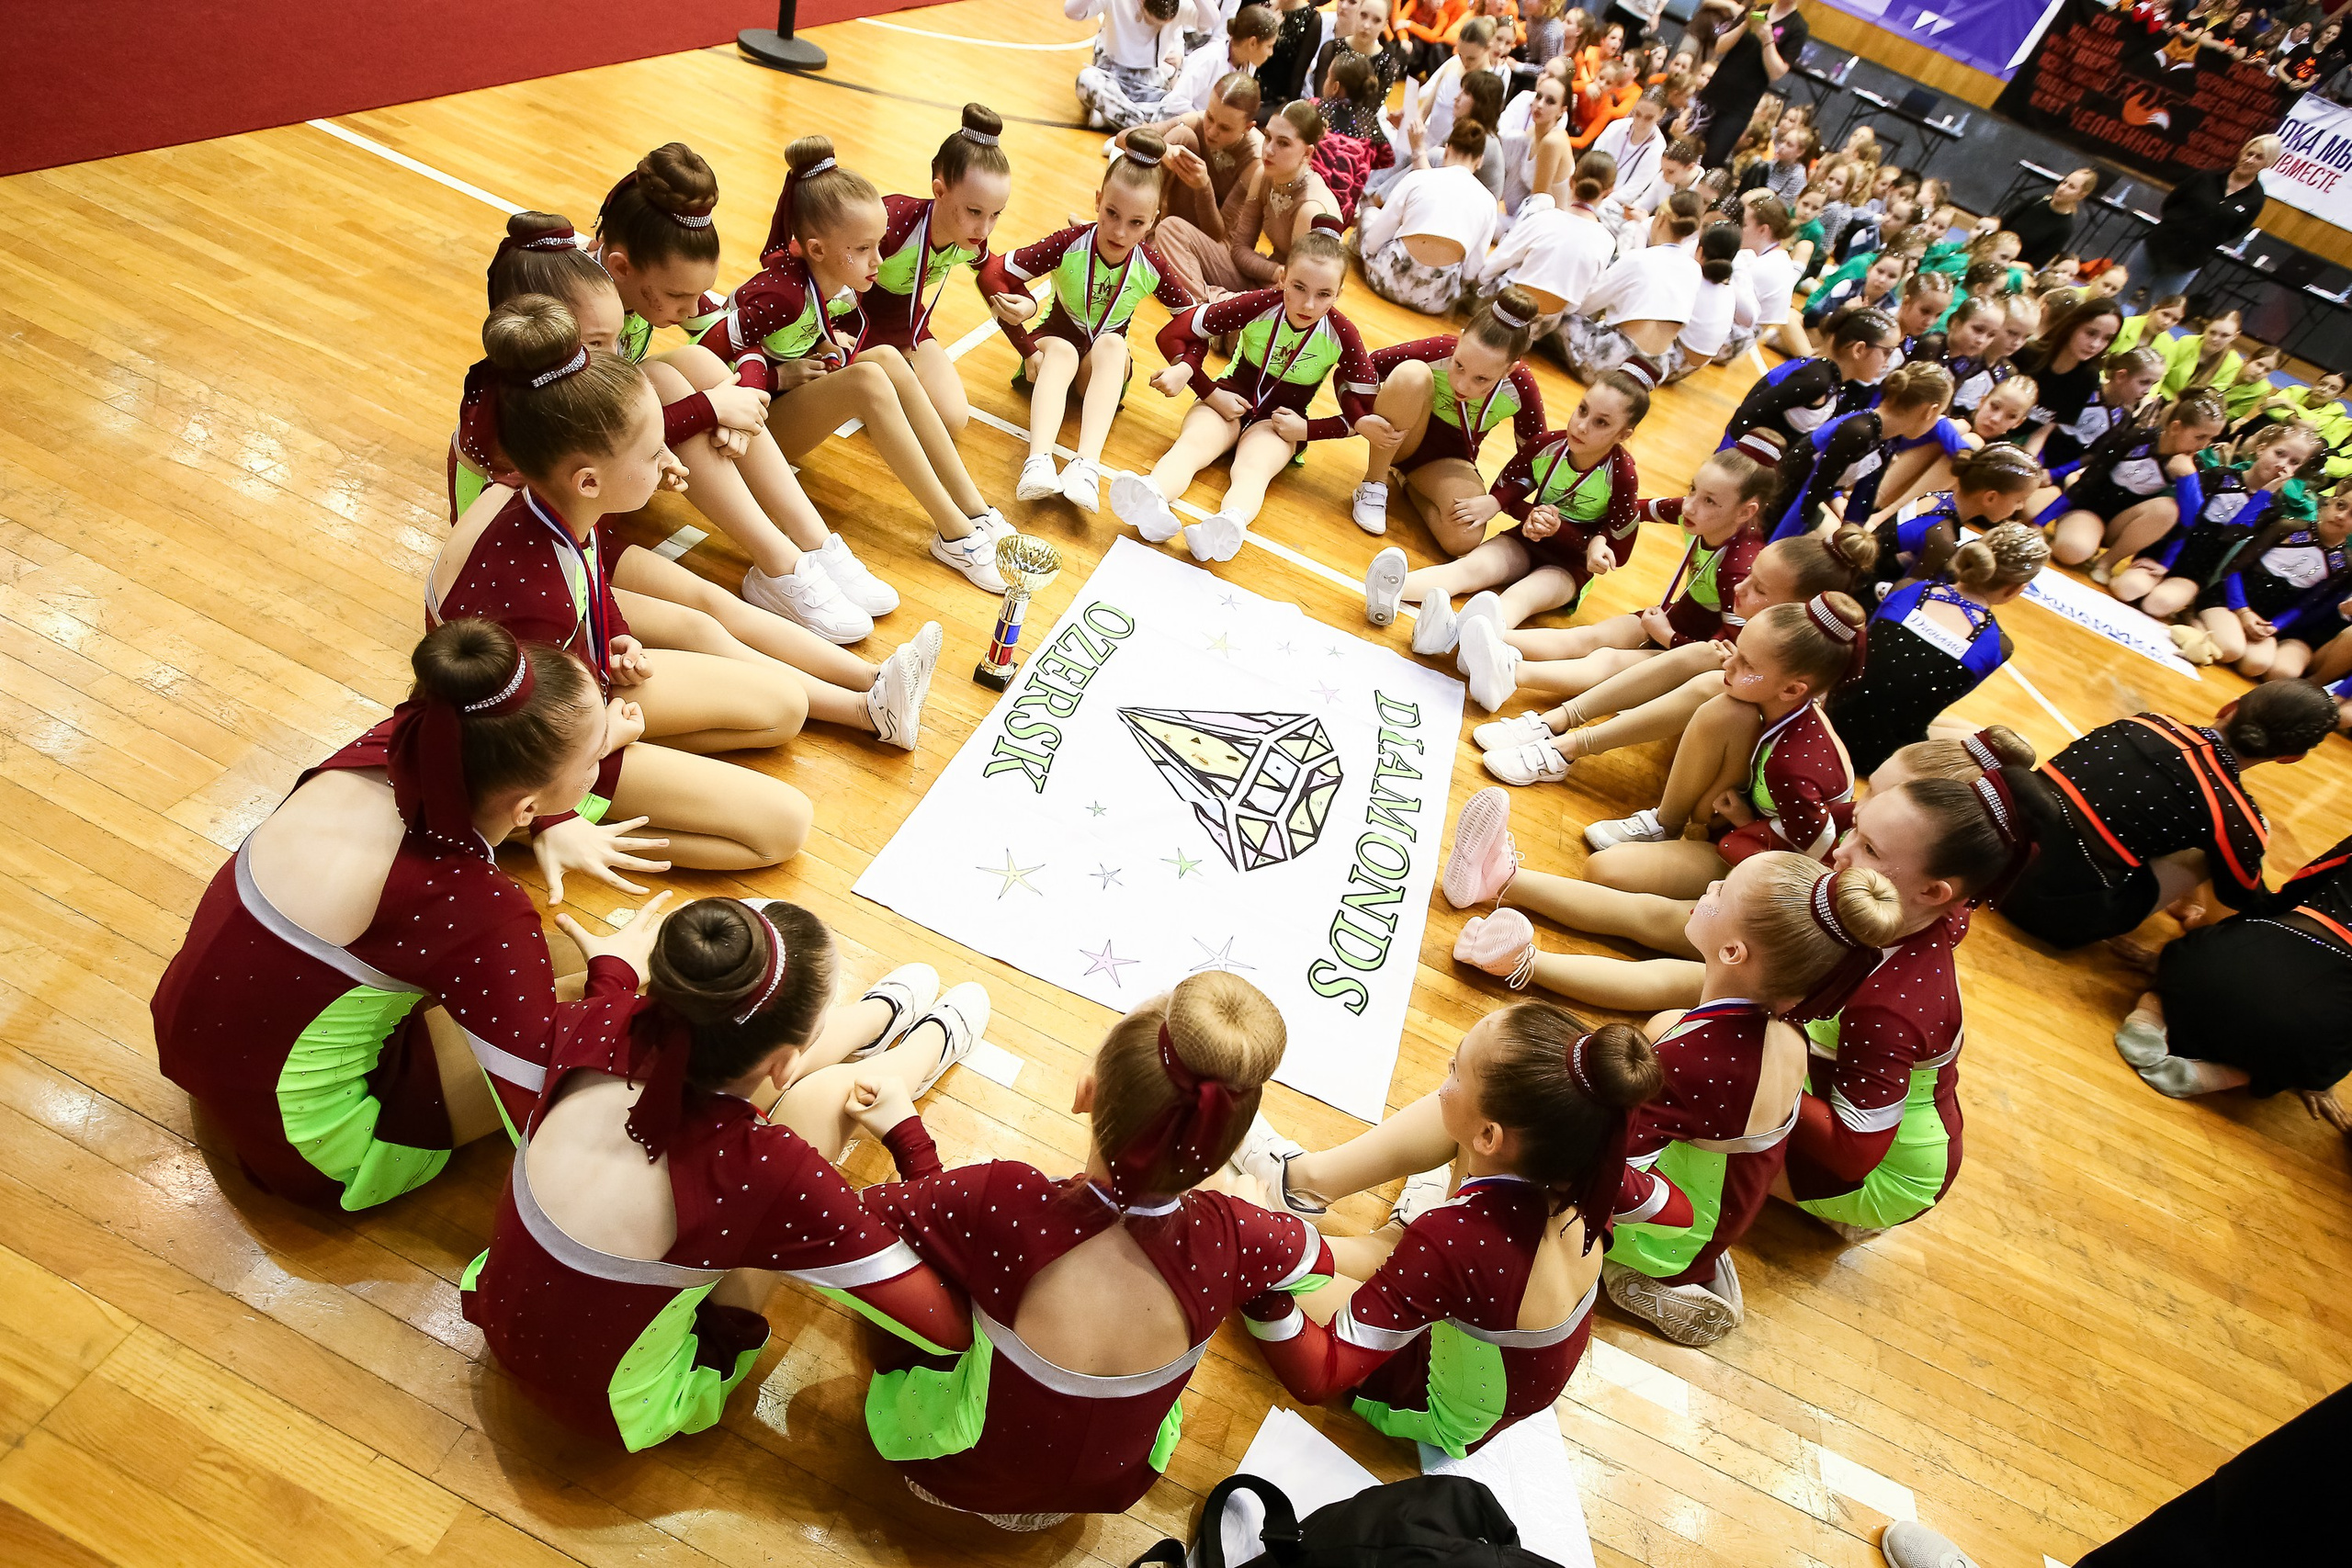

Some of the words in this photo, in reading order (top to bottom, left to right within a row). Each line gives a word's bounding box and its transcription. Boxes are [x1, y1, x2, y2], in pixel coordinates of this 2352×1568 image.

[2090, 12, 2121, 34] FOX
[2069, 107, 2174, 162] ЧЕЛЯБИНСК
[982, 600, 1136, 795] OZERSK
[1306, 689, 1424, 1017] DIAMONDS
